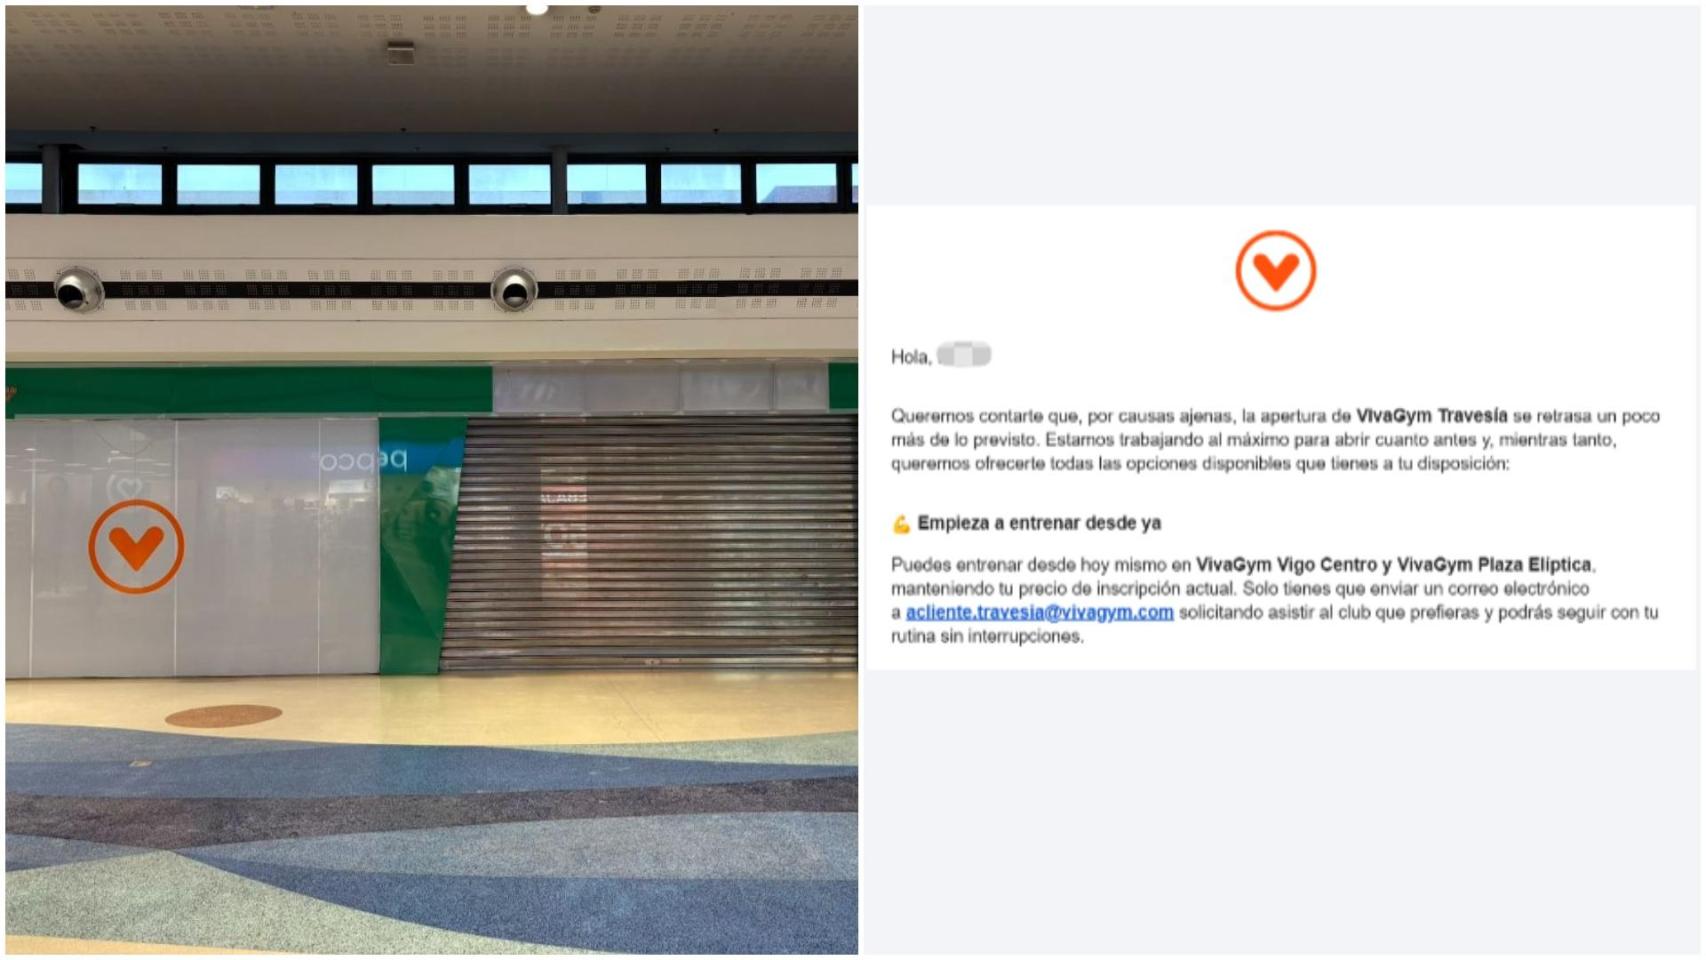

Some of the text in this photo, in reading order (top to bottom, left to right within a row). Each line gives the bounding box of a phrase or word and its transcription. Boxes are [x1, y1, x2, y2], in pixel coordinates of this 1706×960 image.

[891, 348, 933, 366] Hola,
[891, 405, 1661, 428] Queremos contarte que, por causas ajenas, la apertura de VivaGym Travesía se retrasa un poco
[891, 431, 1617, 451] más de lo previsto. Estamos trabajando al máximo para abrir cuanto antes y, mientras tanto,
[890, 454, 1510, 475] queremos ofrecerte todas las opciones disponibles que tienes a tu disposición:
[917, 513, 1163, 535] Empieza a entrenar desde ya
[891, 555, 952, 573] Puedes
[955, 557, 1024, 573] entrenar
[1026, 555, 1077, 573] desde
[1080, 556, 1110, 577] hoy
[1114, 555, 1168, 573] mismo
[1171, 559, 1192, 573] en
[1195, 555, 1273, 577] VivaGym
[1276, 555, 1317, 577] Vigo
[1319, 555, 1379, 573] Centro
[1381, 559, 1393, 577] y
[1396, 555, 1474, 577] VivaGym
[1477, 555, 1524, 573] Plaza
[891, 579, 1590, 601] manteniendo tu precio de inscripción actual. Solo tienes que enviar un correo electrónico
[891, 607, 902, 621] a
[1178, 603, 1264, 621] solicitando
[1267, 604, 1316, 621] asistir
[1318, 603, 1334, 621] al
[1337, 603, 1372, 621] club
[1374, 607, 1406, 624] que
[1409, 603, 1481, 624] prefieras
[1483, 607, 1494, 624] y
[1498, 603, 1554, 625] podrás
[1556, 604, 1607, 625] seguir
[1609, 607, 1640, 621] con
[1643, 605, 1659, 621] tu
[891, 627, 1085, 648] rutina sin interrupciones.
